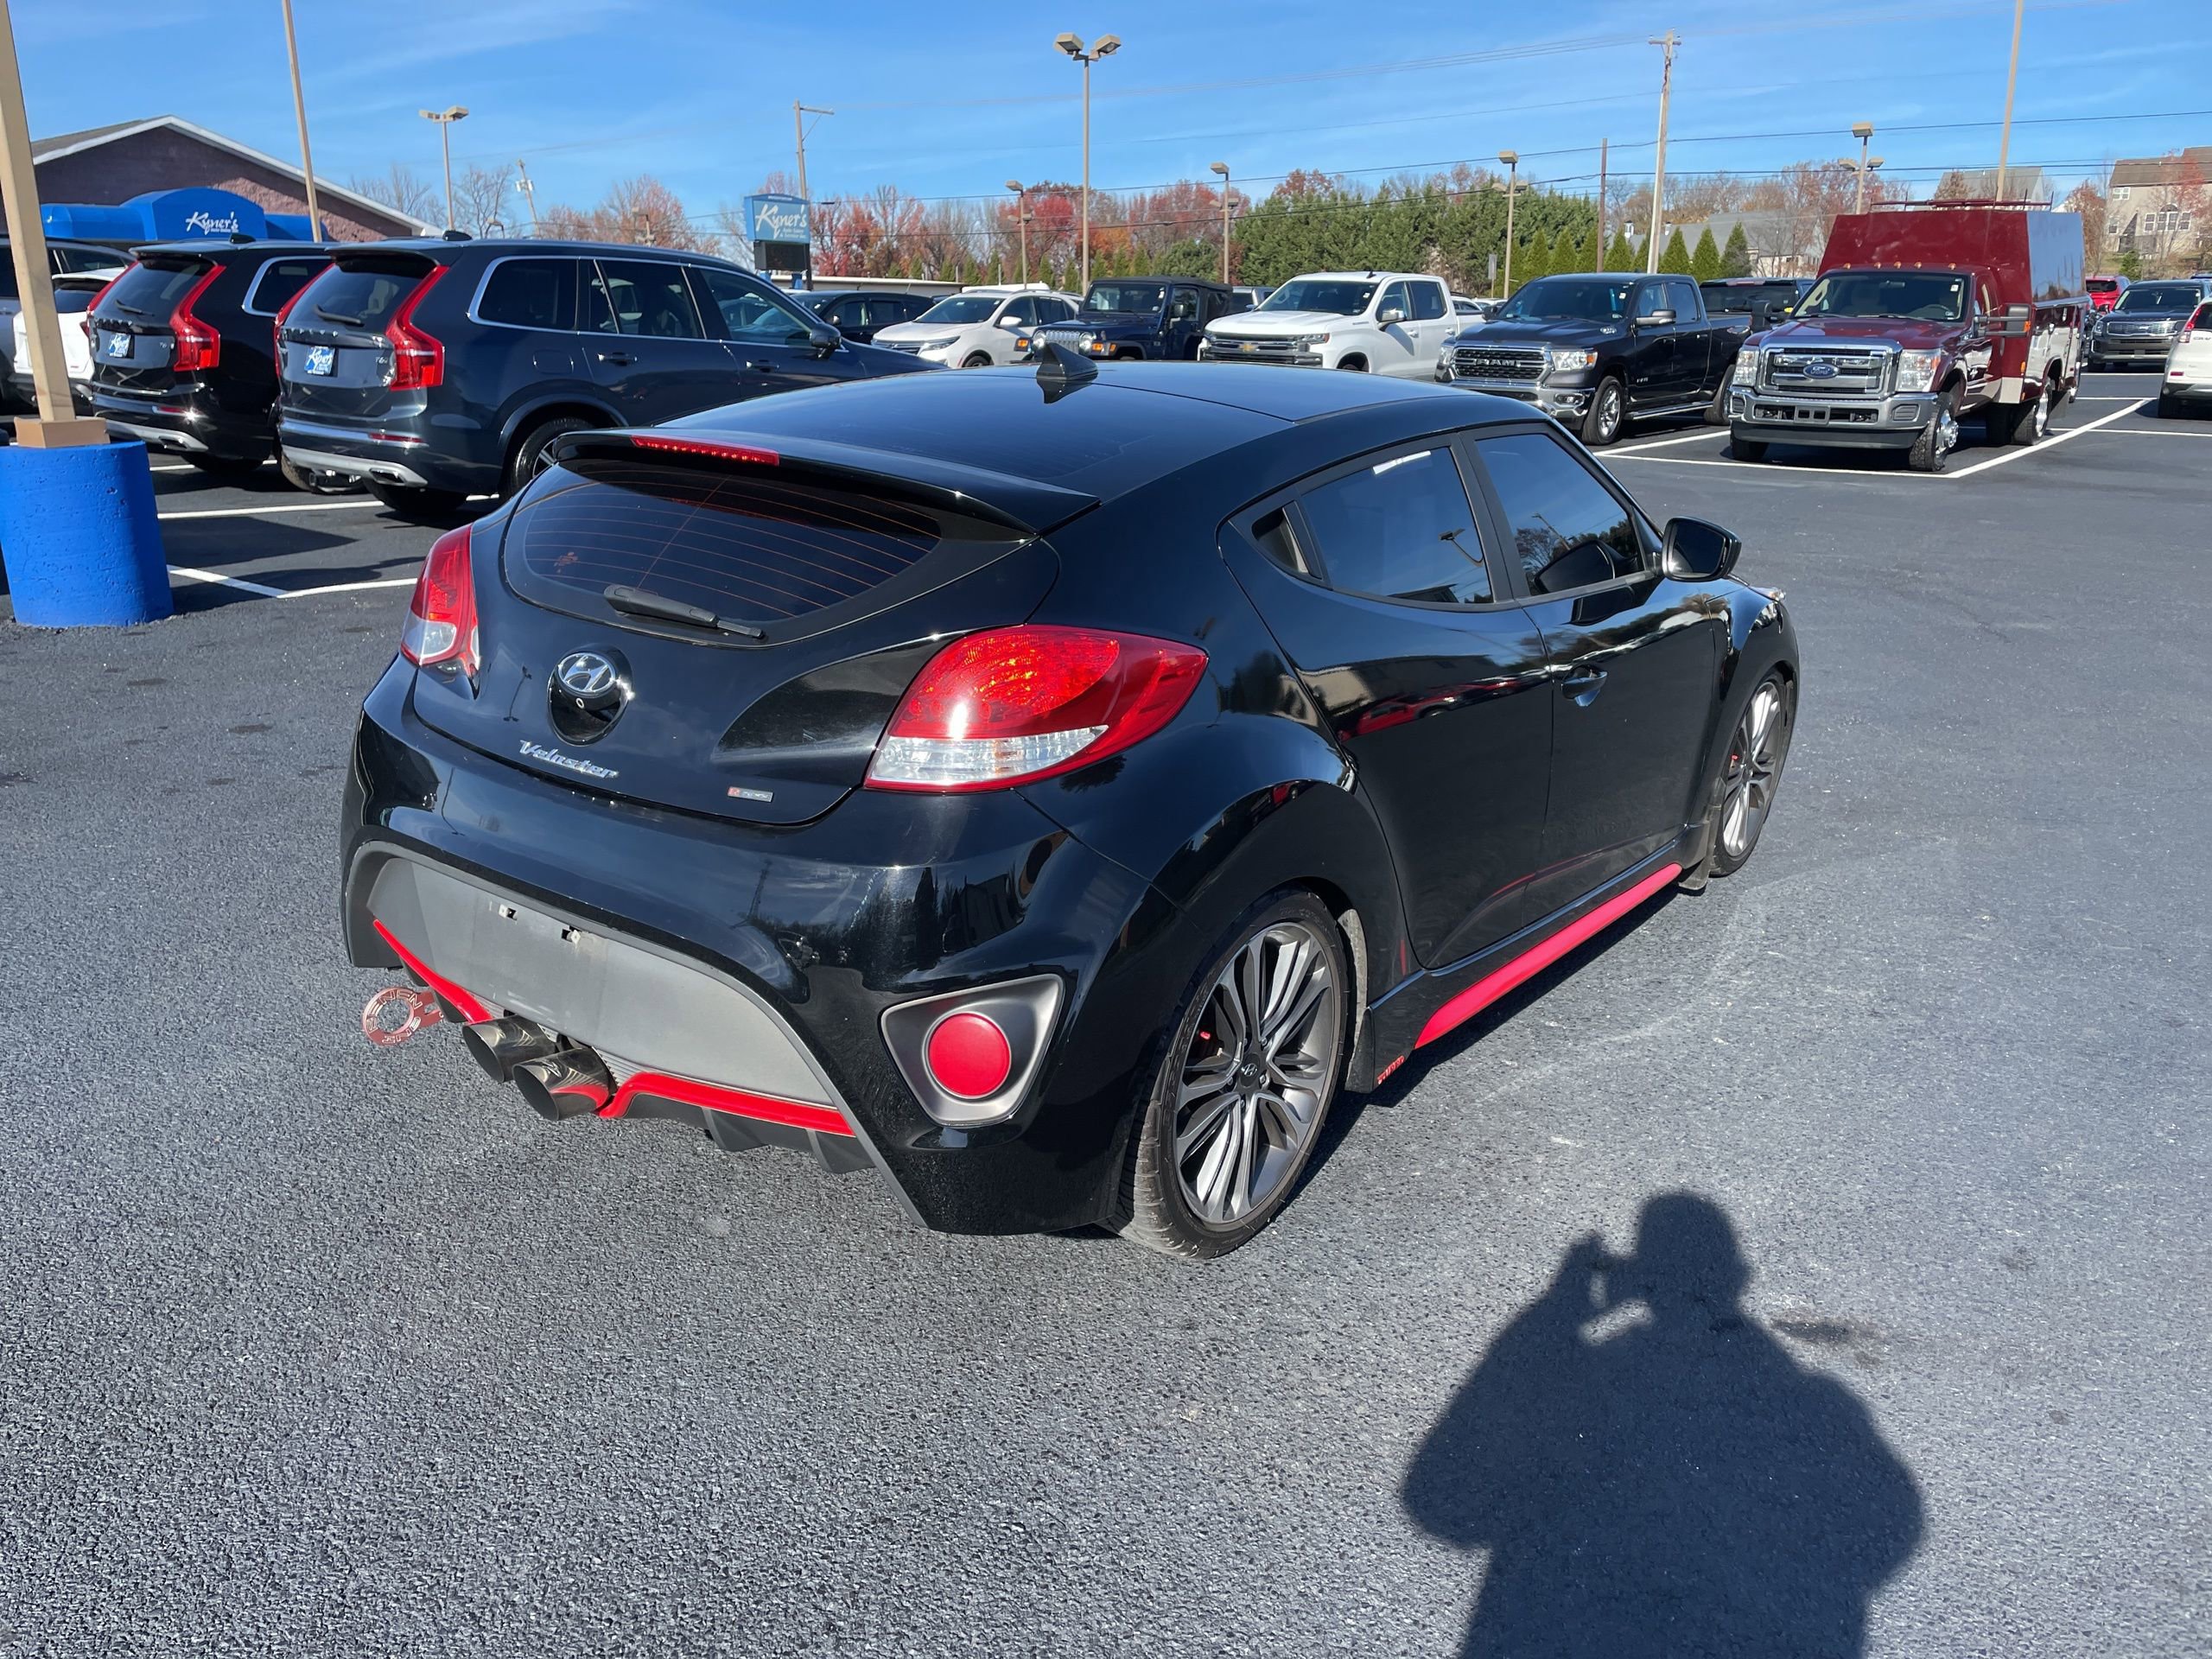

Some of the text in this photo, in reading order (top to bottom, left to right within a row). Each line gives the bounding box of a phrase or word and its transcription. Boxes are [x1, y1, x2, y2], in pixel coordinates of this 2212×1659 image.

[186, 211, 238, 235] Kyner's
[755, 203, 807, 239] Kyner's
[1477, 359, 1516, 367] RAM
[519, 740, 619, 778] Veloster
